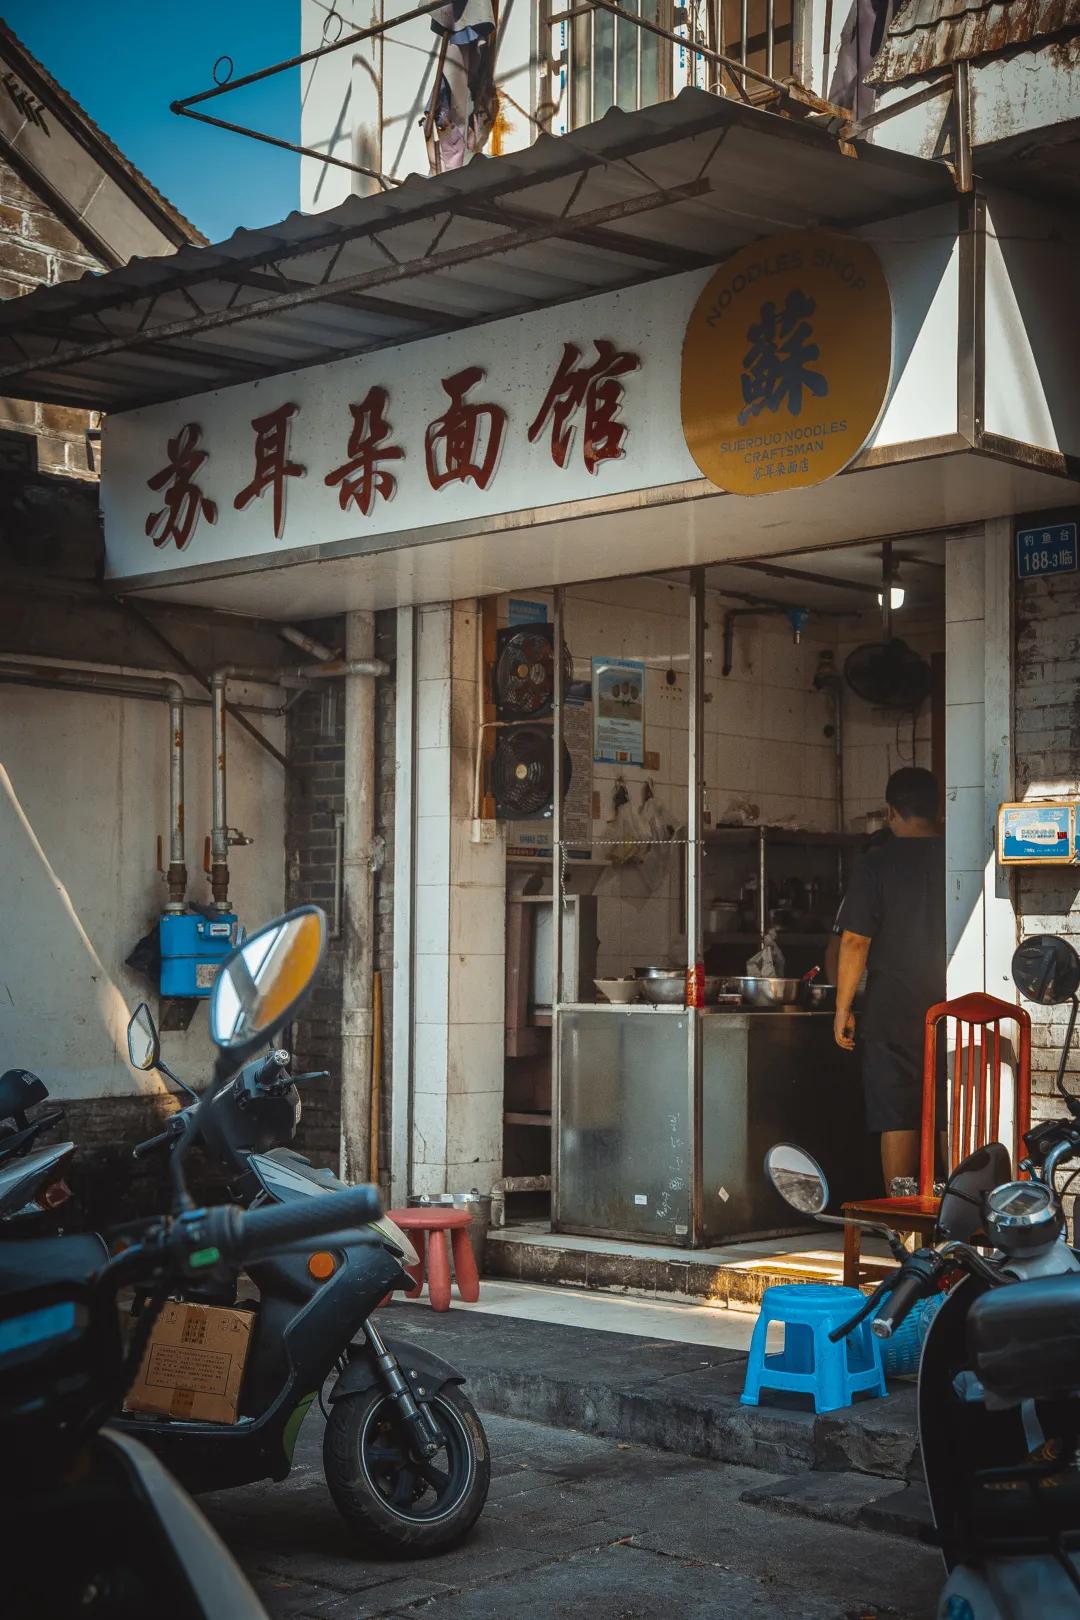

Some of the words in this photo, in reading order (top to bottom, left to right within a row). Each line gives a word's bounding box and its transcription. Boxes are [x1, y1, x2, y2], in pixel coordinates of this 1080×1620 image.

[705, 252, 804, 328] NOODLES
[815, 248, 867, 292] SHOP
[145, 339, 642, 551] 苏耳朵面馆
[720, 432, 782, 454] SUERDUO
[784, 419, 848, 442] NOODLES
[744, 440, 824, 464] CRAFTSMAN
